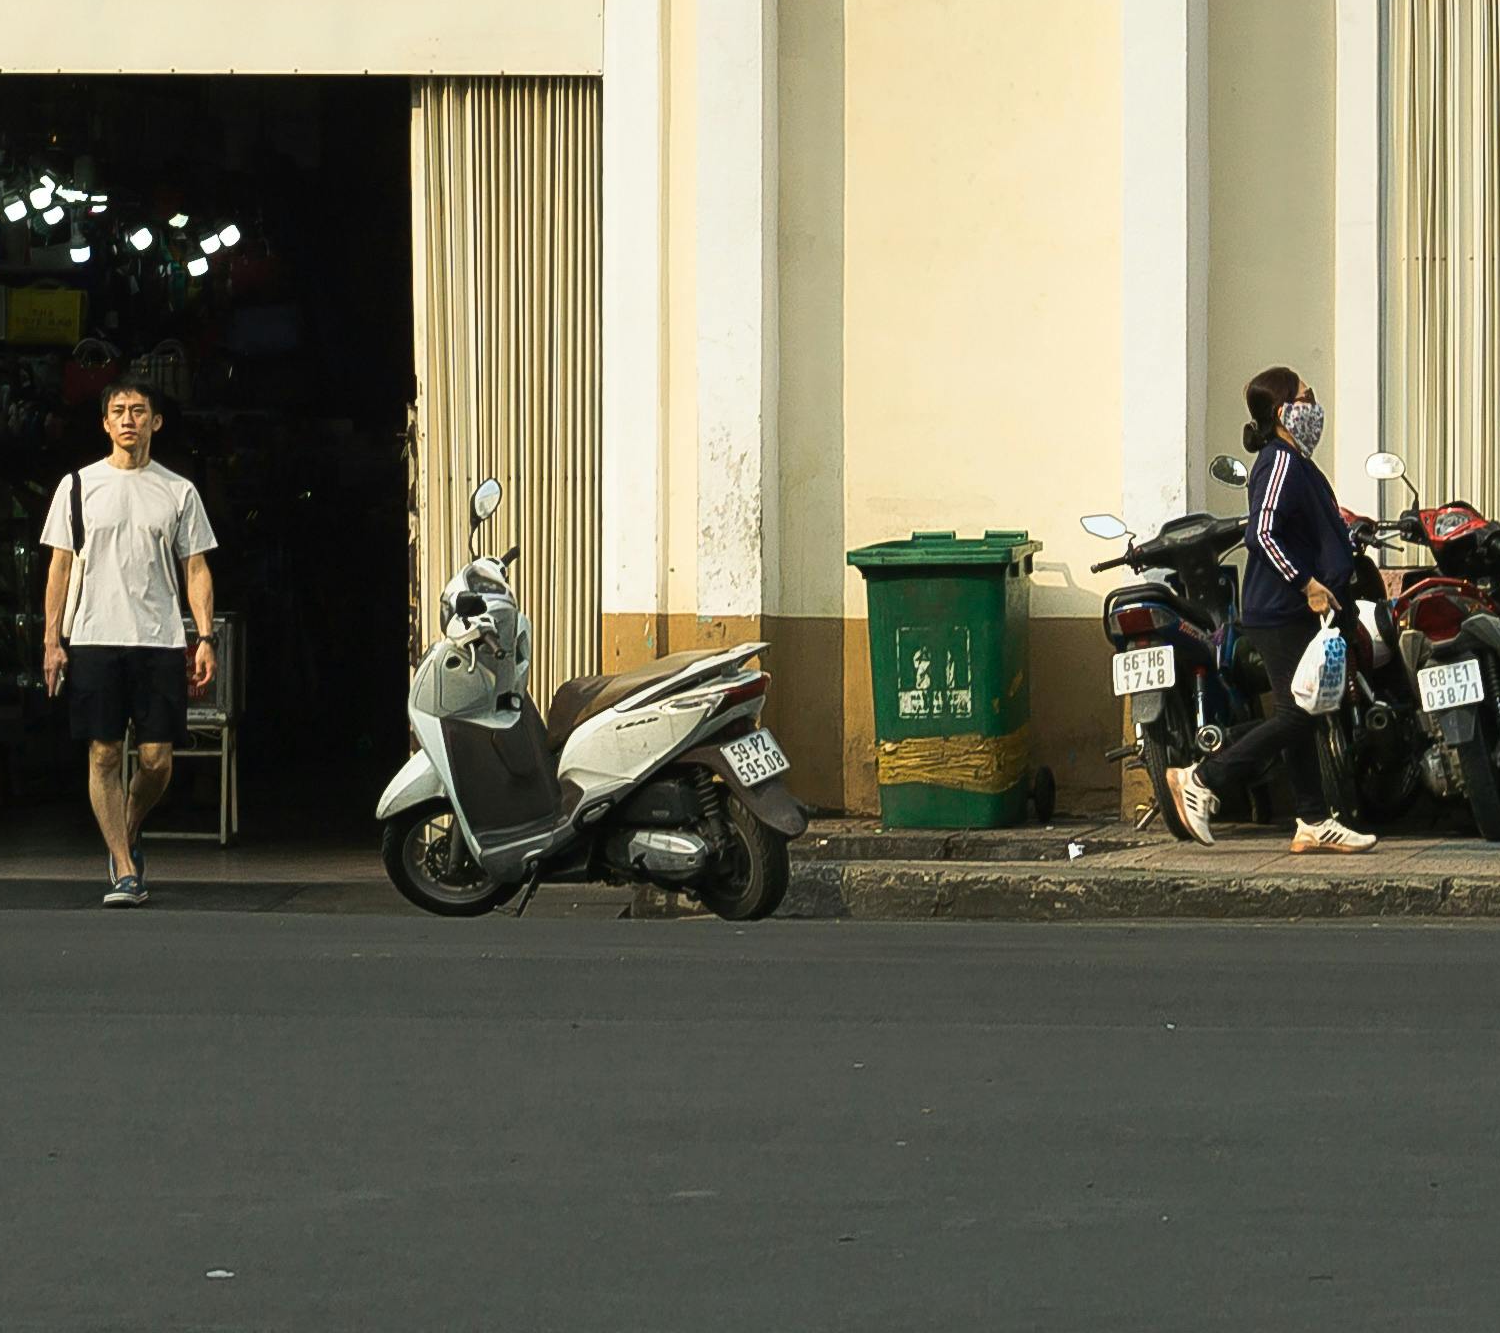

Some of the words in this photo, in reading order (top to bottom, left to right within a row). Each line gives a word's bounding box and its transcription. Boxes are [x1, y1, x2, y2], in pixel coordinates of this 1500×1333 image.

[1123, 669, 1165, 690] 1748
[1427, 683, 1480, 708] 038.71
[730, 733, 770, 763] 59-P2
[738, 750, 785, 783] 595.08
